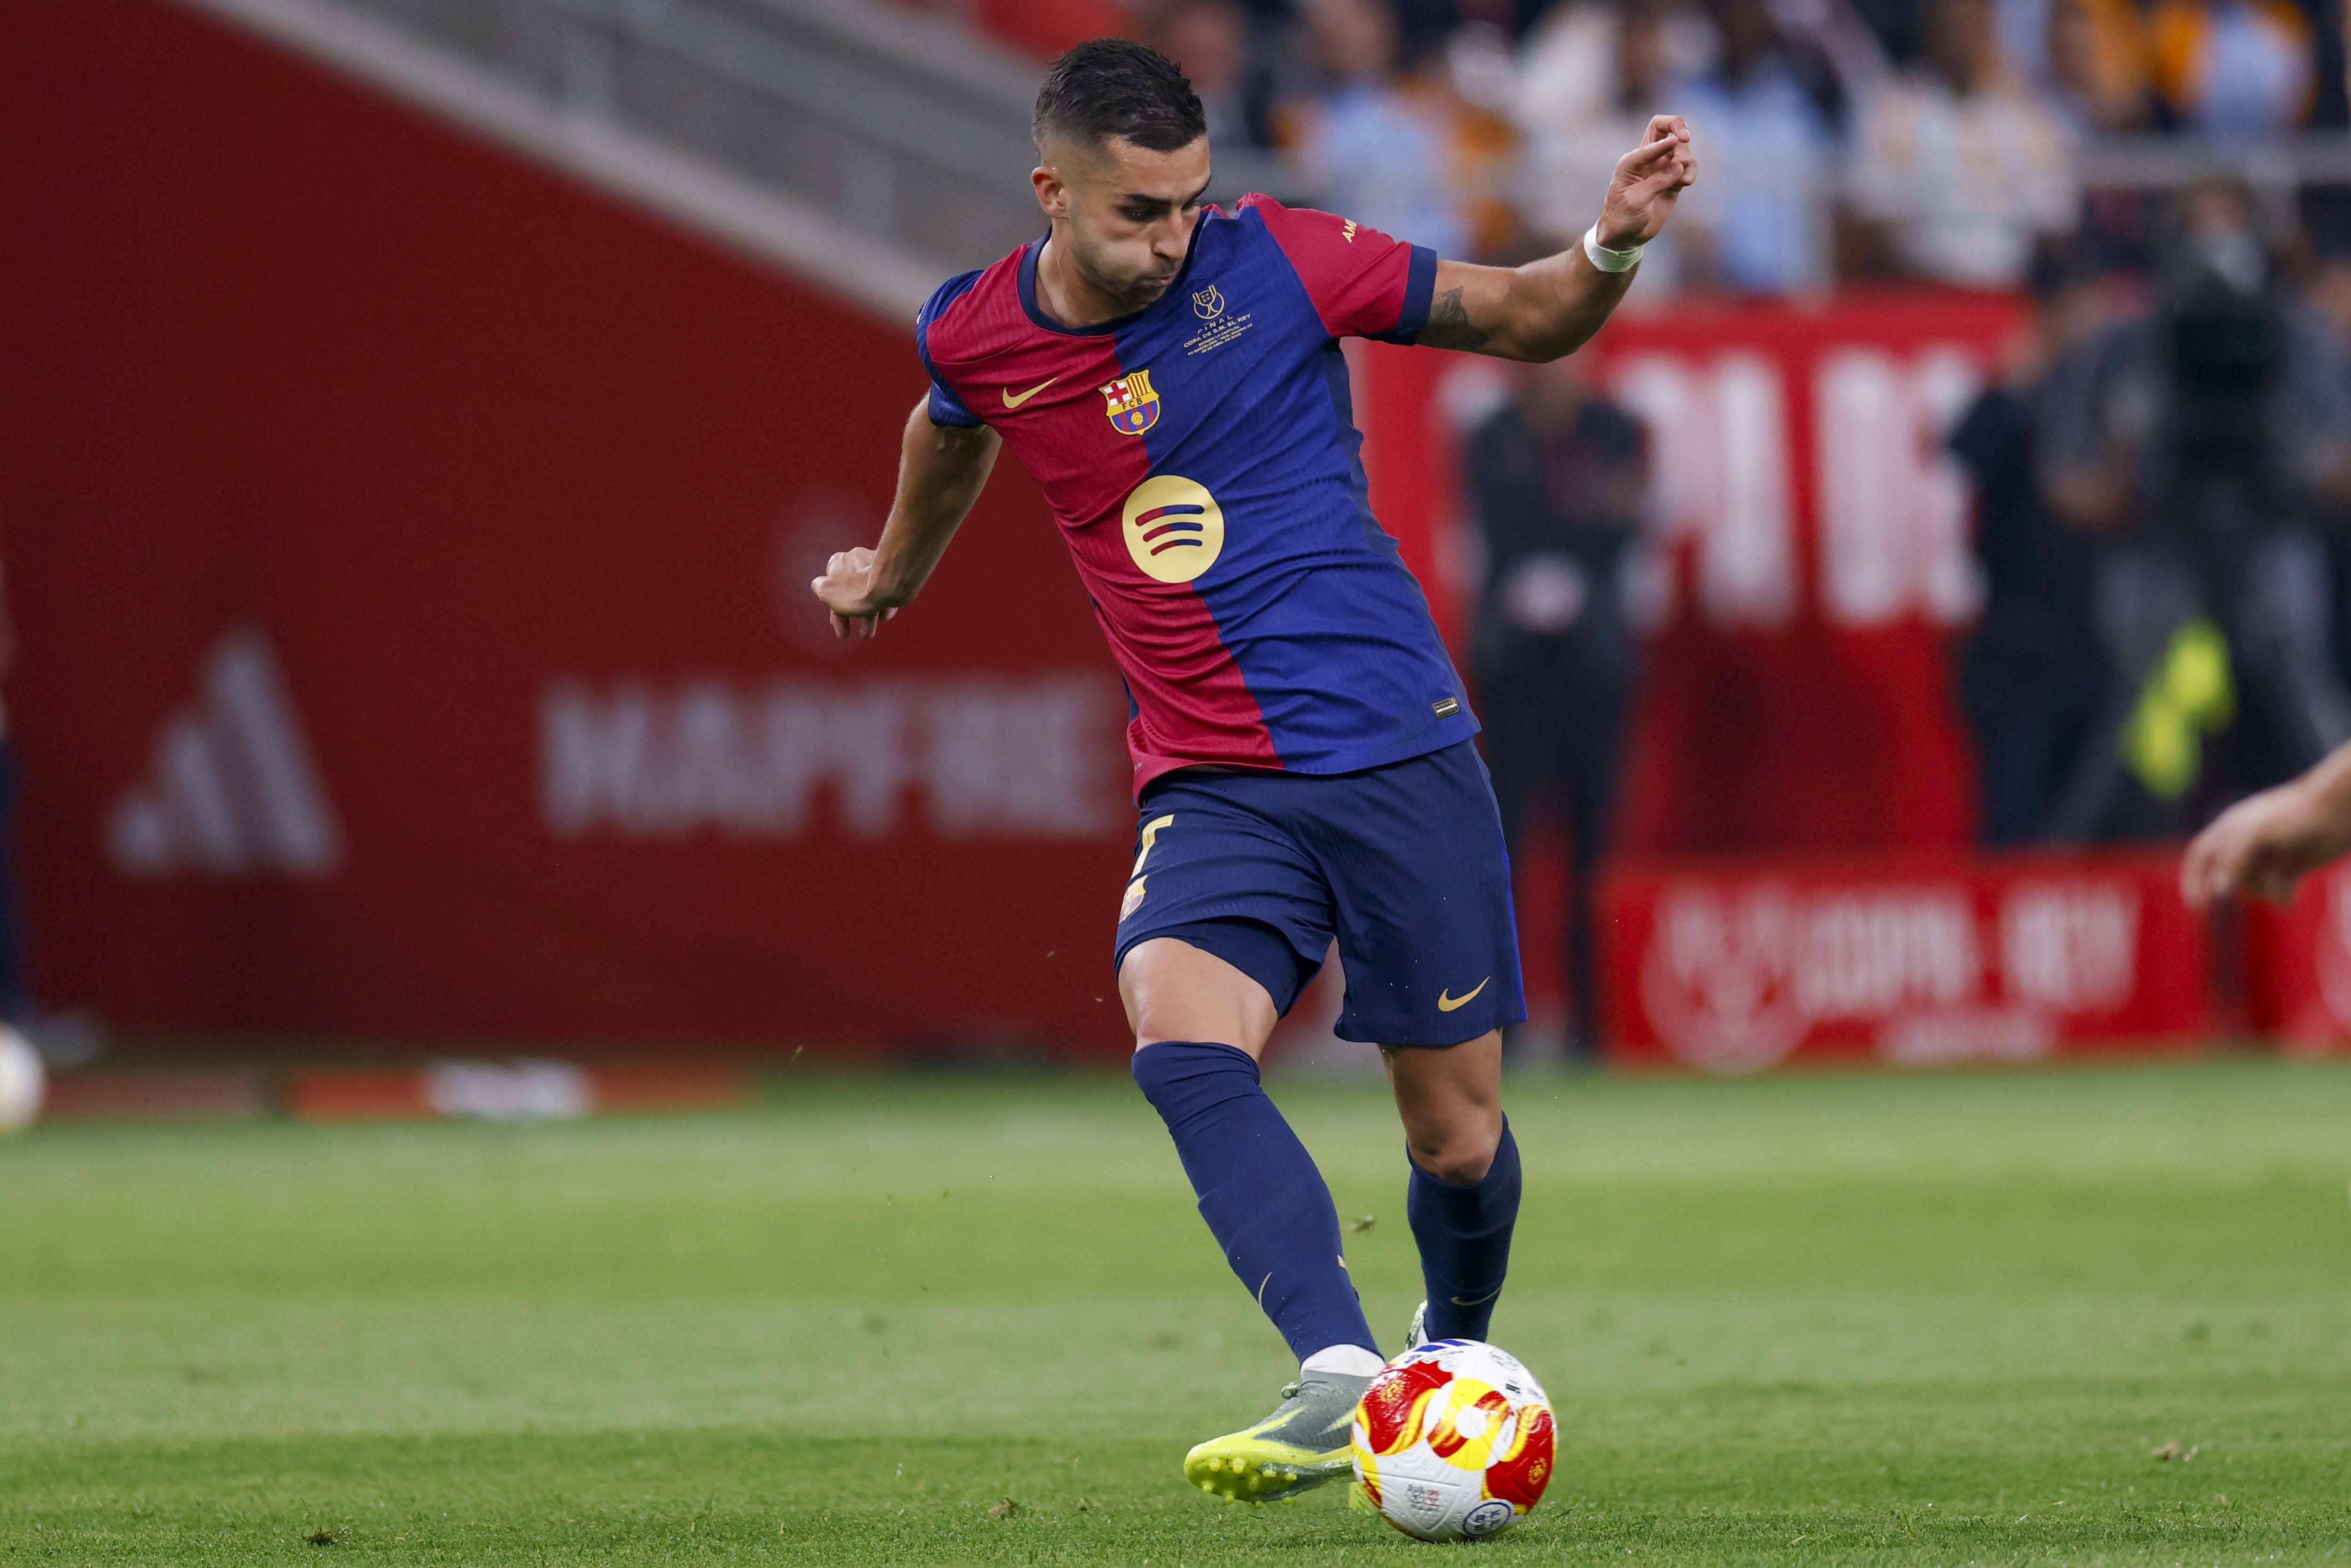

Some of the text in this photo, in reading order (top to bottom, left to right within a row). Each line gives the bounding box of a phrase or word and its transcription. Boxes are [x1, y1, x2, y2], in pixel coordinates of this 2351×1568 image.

[1184, 337, 1201, 347] COPA
[1237, 314, 1251, 322] REY
[1198, 315, 1233, 334] FINAL
[1194, 339, 1218, 353] BARCELONA
[1231, 326, 1247, 335] MADRID
[1198, 337, 1215, 347] ESTADIO
[1221, 325, 1240, 335] CARTUJA
[1122, 398, 1143, 410] FCB
